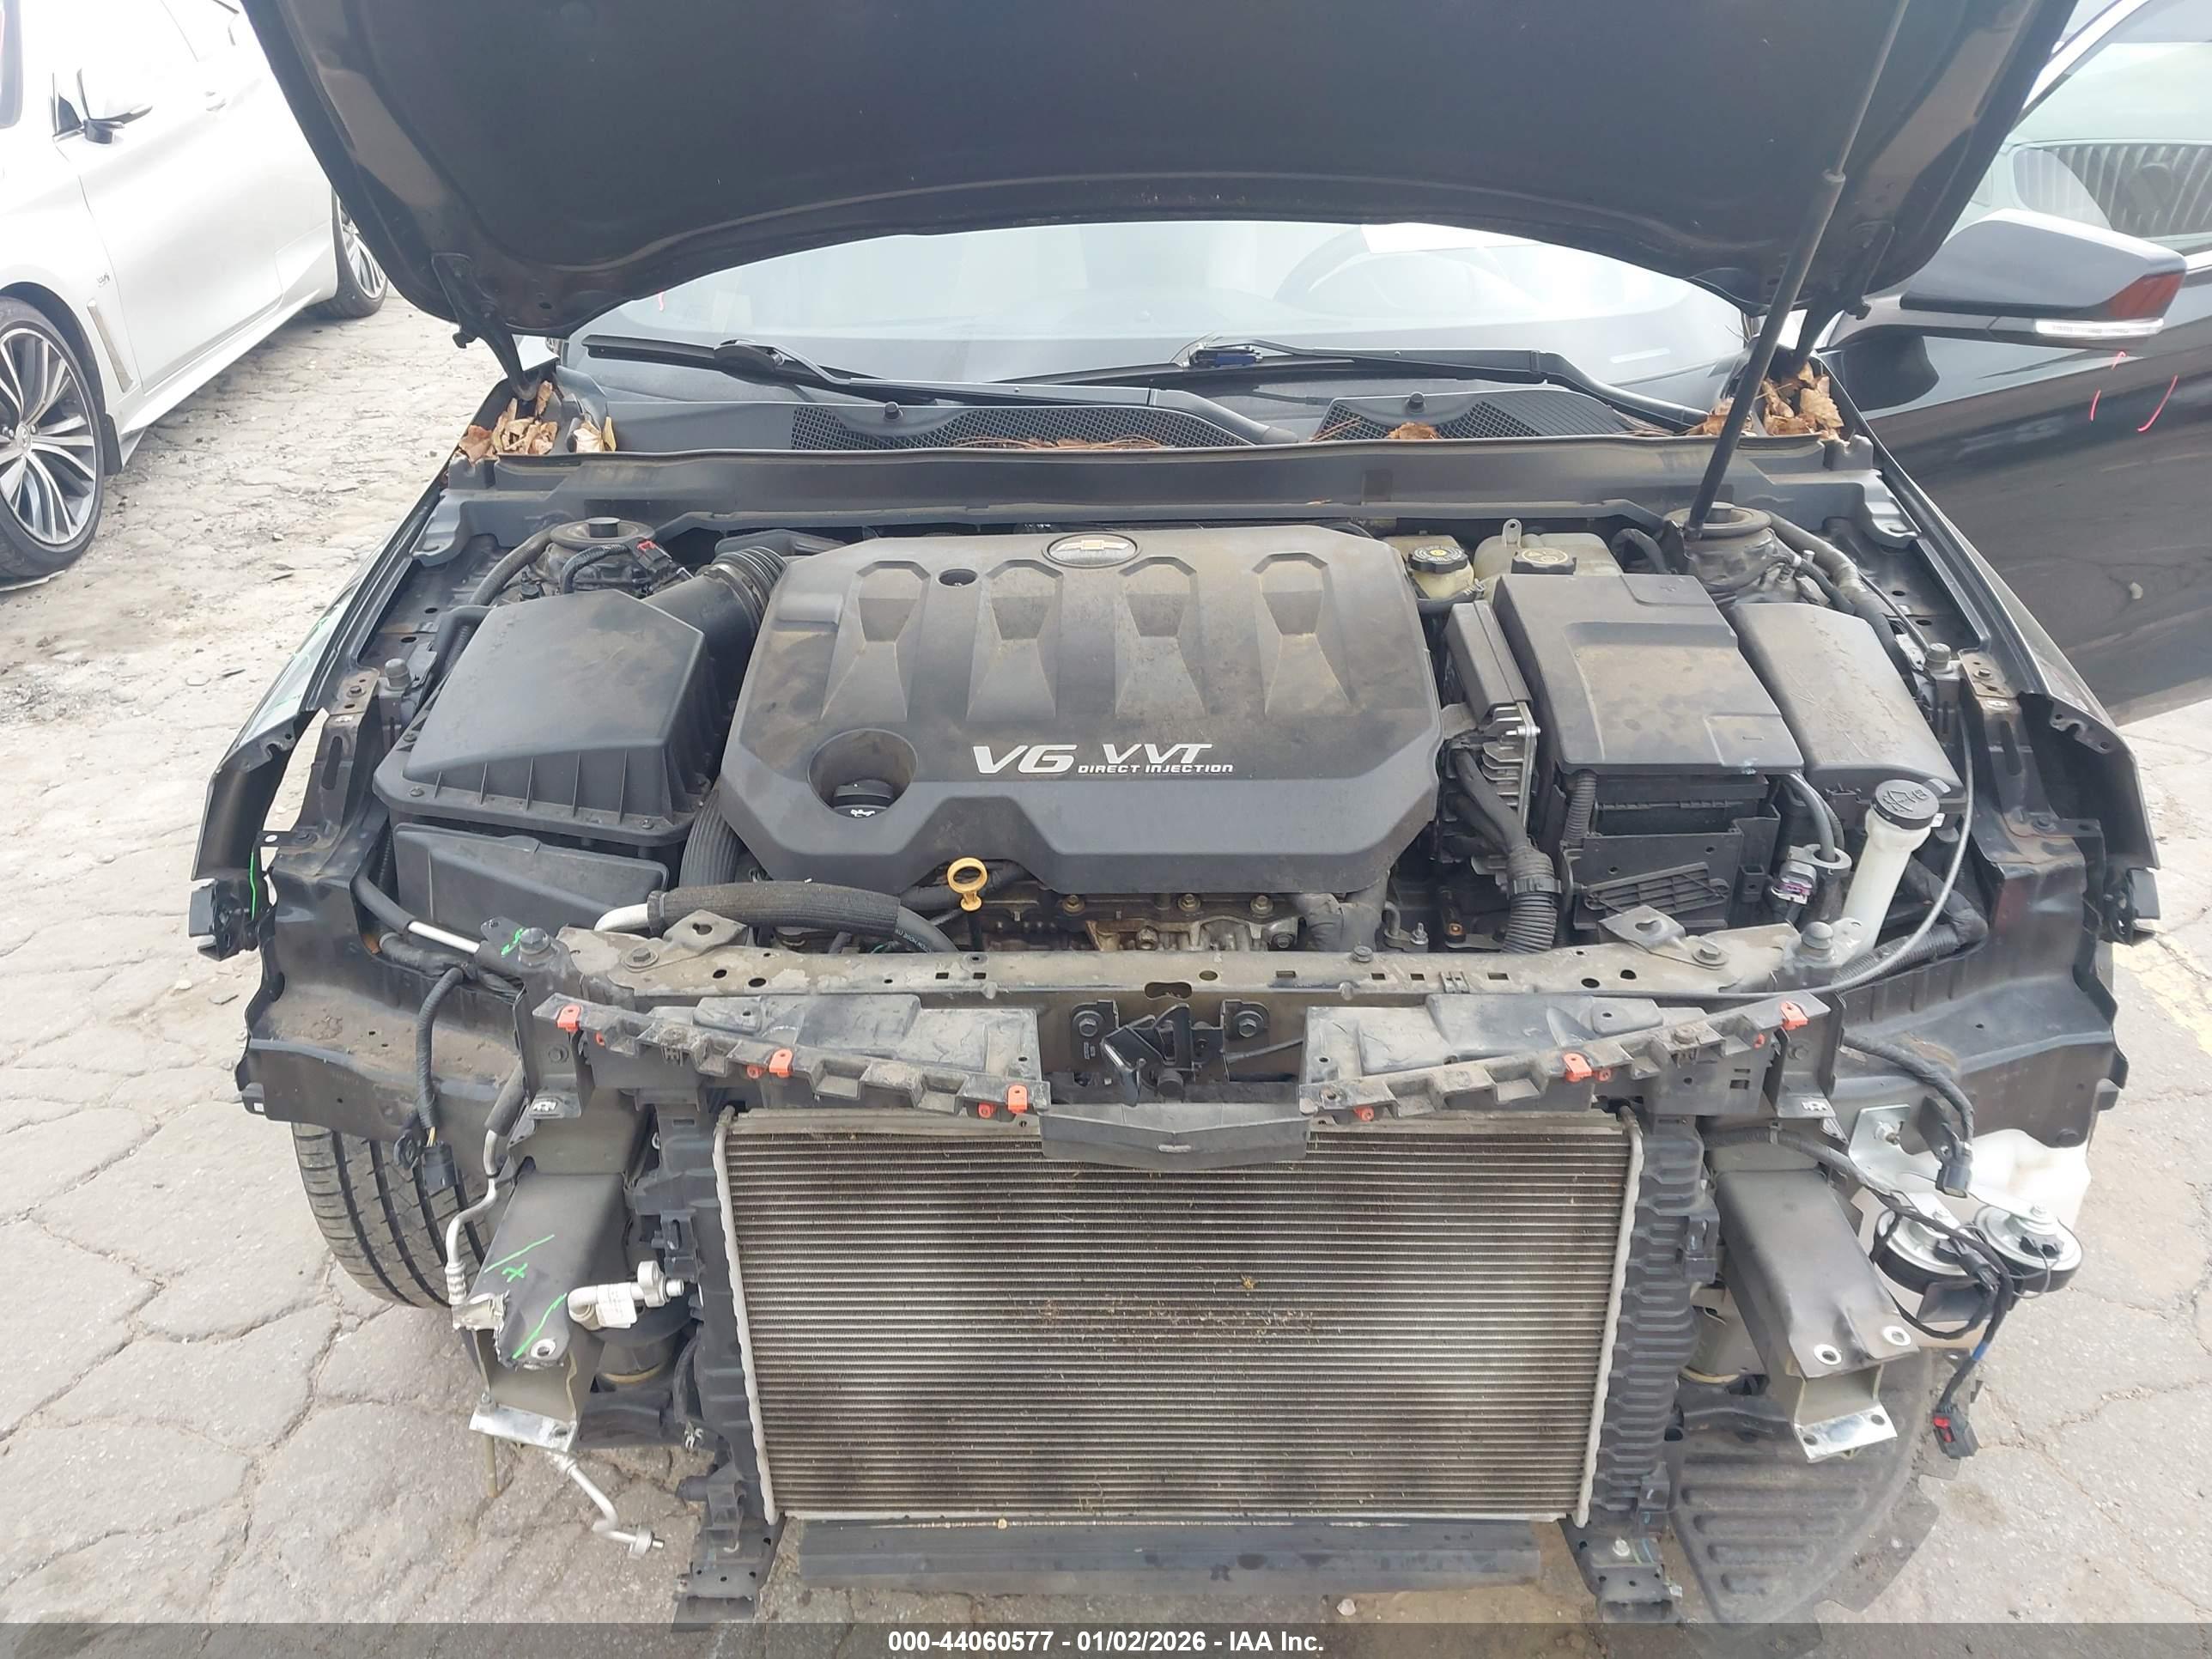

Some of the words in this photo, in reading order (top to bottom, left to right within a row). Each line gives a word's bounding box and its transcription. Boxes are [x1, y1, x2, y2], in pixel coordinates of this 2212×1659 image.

[973, 744, 1078, 775] V6
[1102, 743, 1213, 764] VVT
[1078, 763, 1141, 774] DIRECT
[1145, 763, 1234, 774] INJECTION
